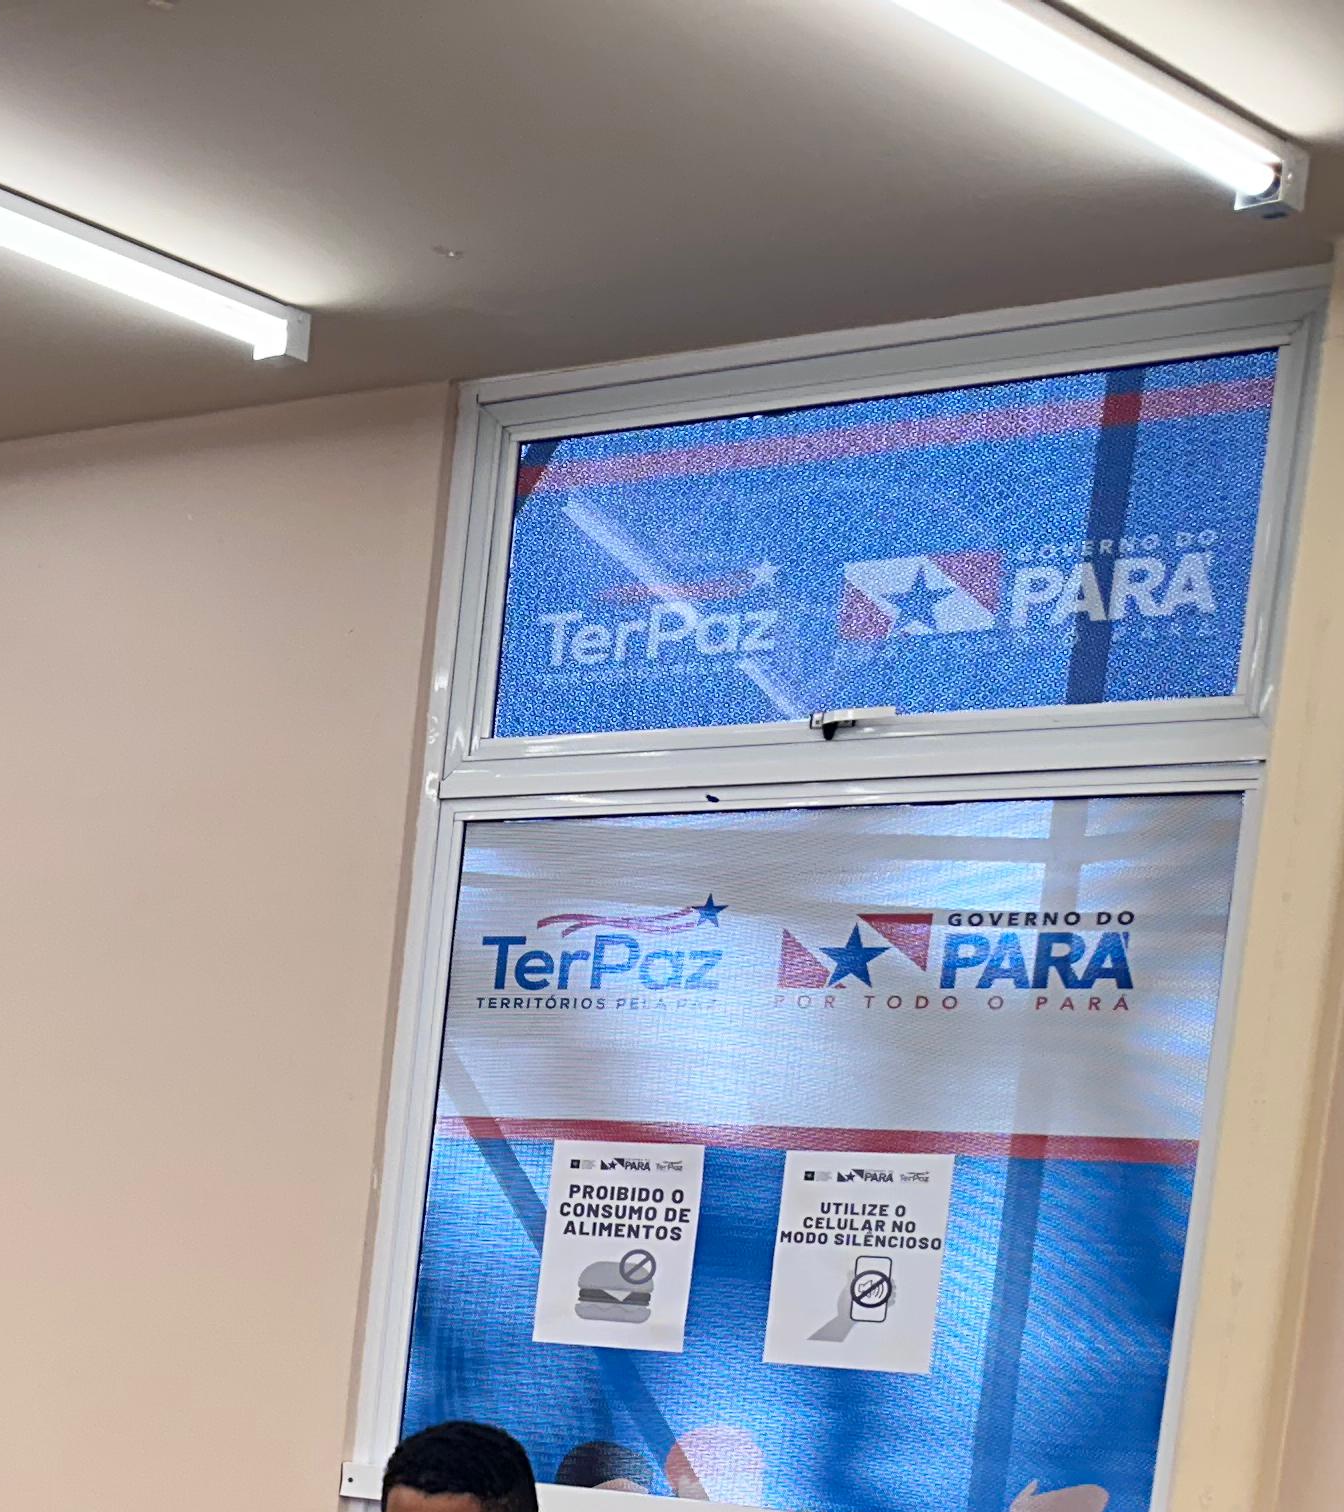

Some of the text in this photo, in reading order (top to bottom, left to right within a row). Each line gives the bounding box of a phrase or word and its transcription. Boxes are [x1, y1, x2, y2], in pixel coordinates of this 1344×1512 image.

[538, 600, 779, 668] TerPaz
[947, 911, 1136, 927] GOVERNO DO
[482, 933, 724, 991] TerPaz
[476, 993, 606, 1010] TERRITÓRIOS
[863, 995, 959, 1010] TODO
[988, 997, 1004, 1010] O
[1034, 993, 1130, 1012] PARÁ
[568, 1183, 685, 1204] PROIBIDO O
[559, 1202, 692, 1224] CONSUMO DE
[820, 1201, 907, 1217] UTILIZE O
[562, 1219, 683, 1242] ALIMENTOS
[802, 1216, 917, 1234] CELULAR NO
[779, 1230, 942, 1251] MODO SILÊNCIOSO
